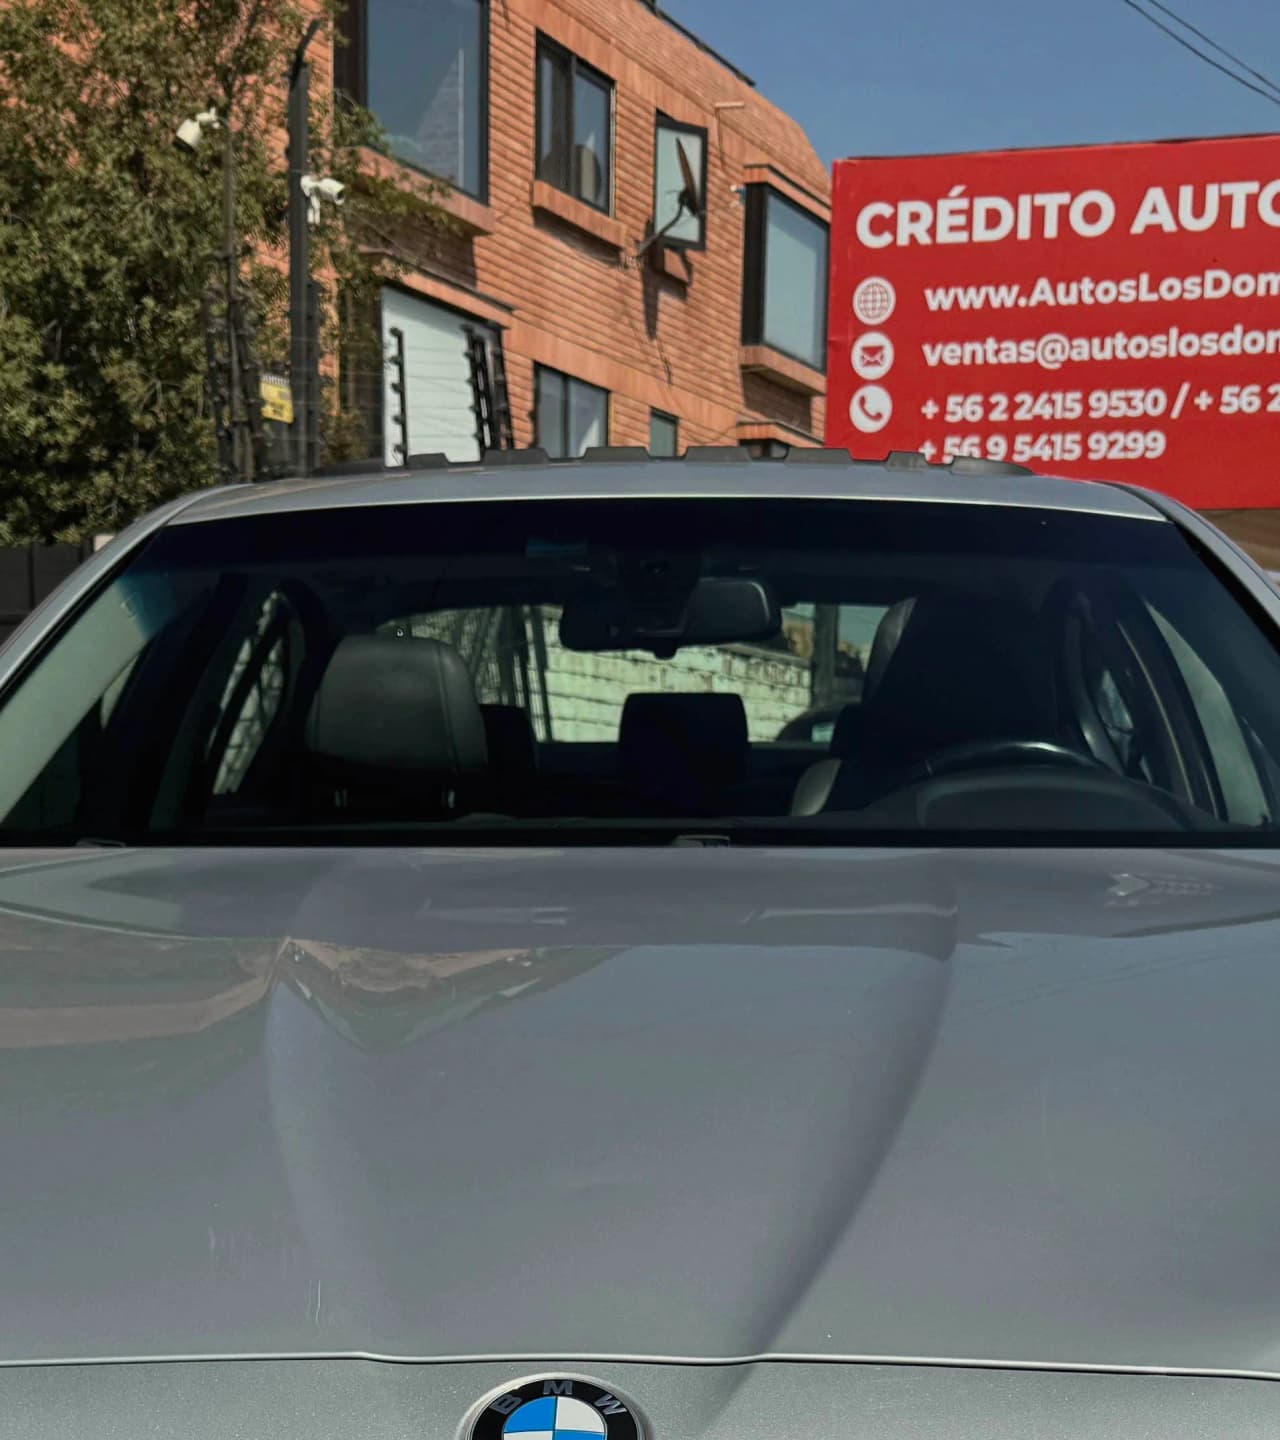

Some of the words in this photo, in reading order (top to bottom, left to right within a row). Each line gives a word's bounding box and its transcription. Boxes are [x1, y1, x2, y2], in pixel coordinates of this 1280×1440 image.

[854, 183, 1117, 249] CRÉDITO
[942, 393, 984, 423] 56
[988, 393, 1009, 422] 2
[1013, 391, 1084, 421] 2415
[1087, 387, 1168, 419] 9530
[1219, 384, 1262, 415] 56
[985, 434, 1008, 462] 9
[1012, 432, 1082, 463] 5415
[1087, 430, 1167, 461] 9299
[489, 1379, 628, 1416] BMW
